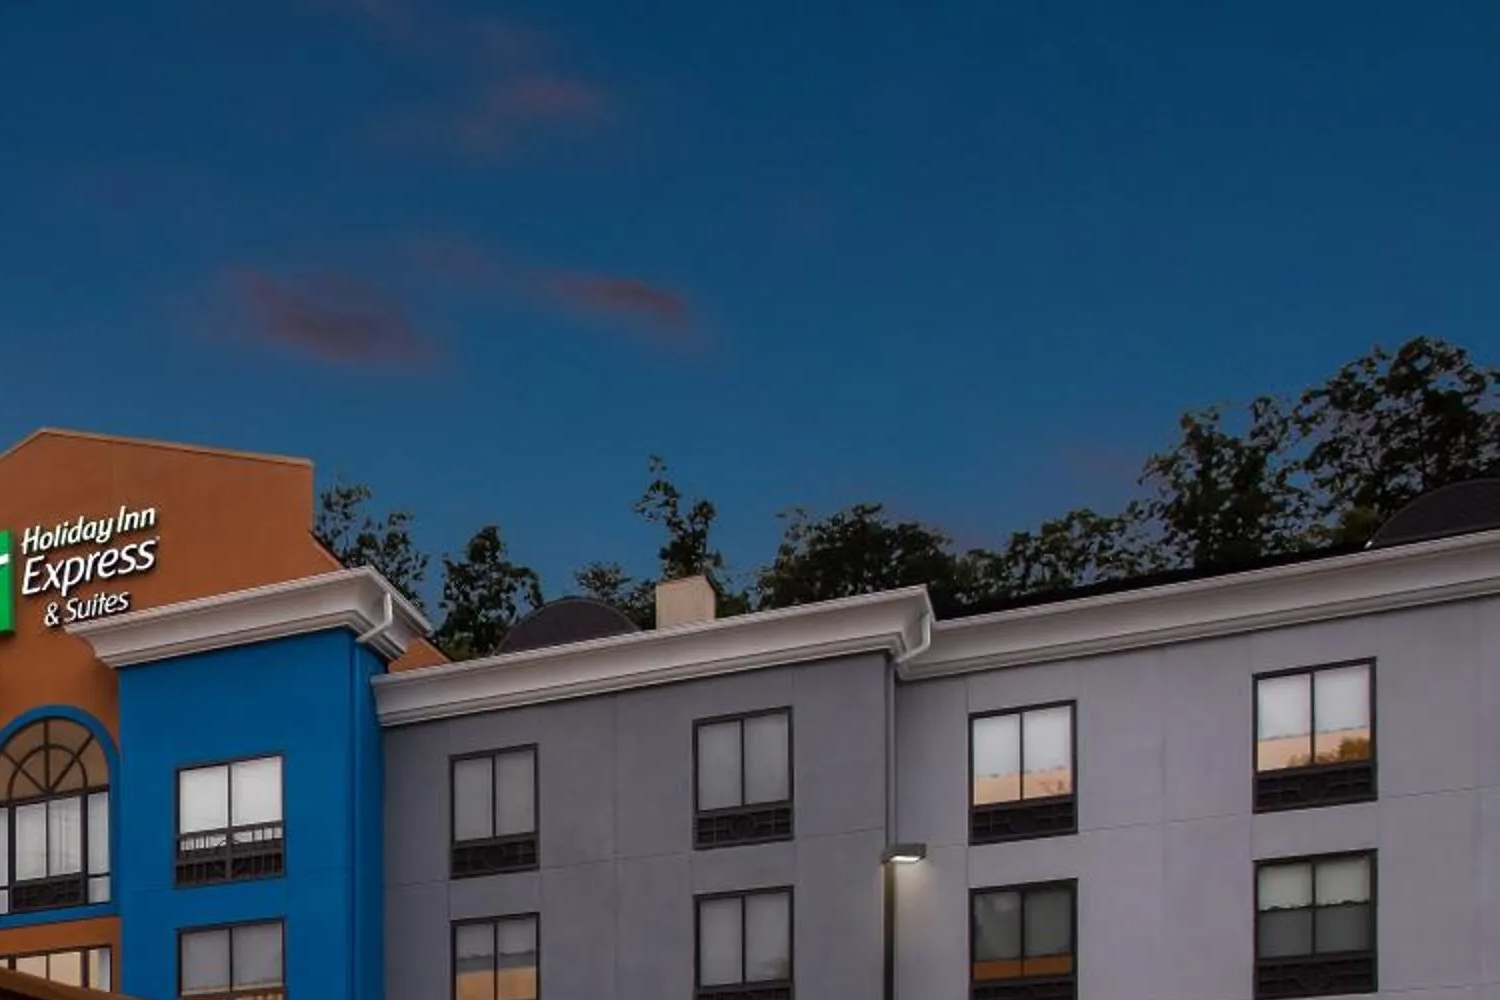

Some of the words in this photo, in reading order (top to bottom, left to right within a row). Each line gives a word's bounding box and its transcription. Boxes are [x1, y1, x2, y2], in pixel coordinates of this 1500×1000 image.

[21, 514, 113, 554] Holiday
[116, 505, 156, 533] Inn
[21, 539, 156, 597] Express
[43, 602, 60, 626] &
[63, 591, 129, 623] Suites
